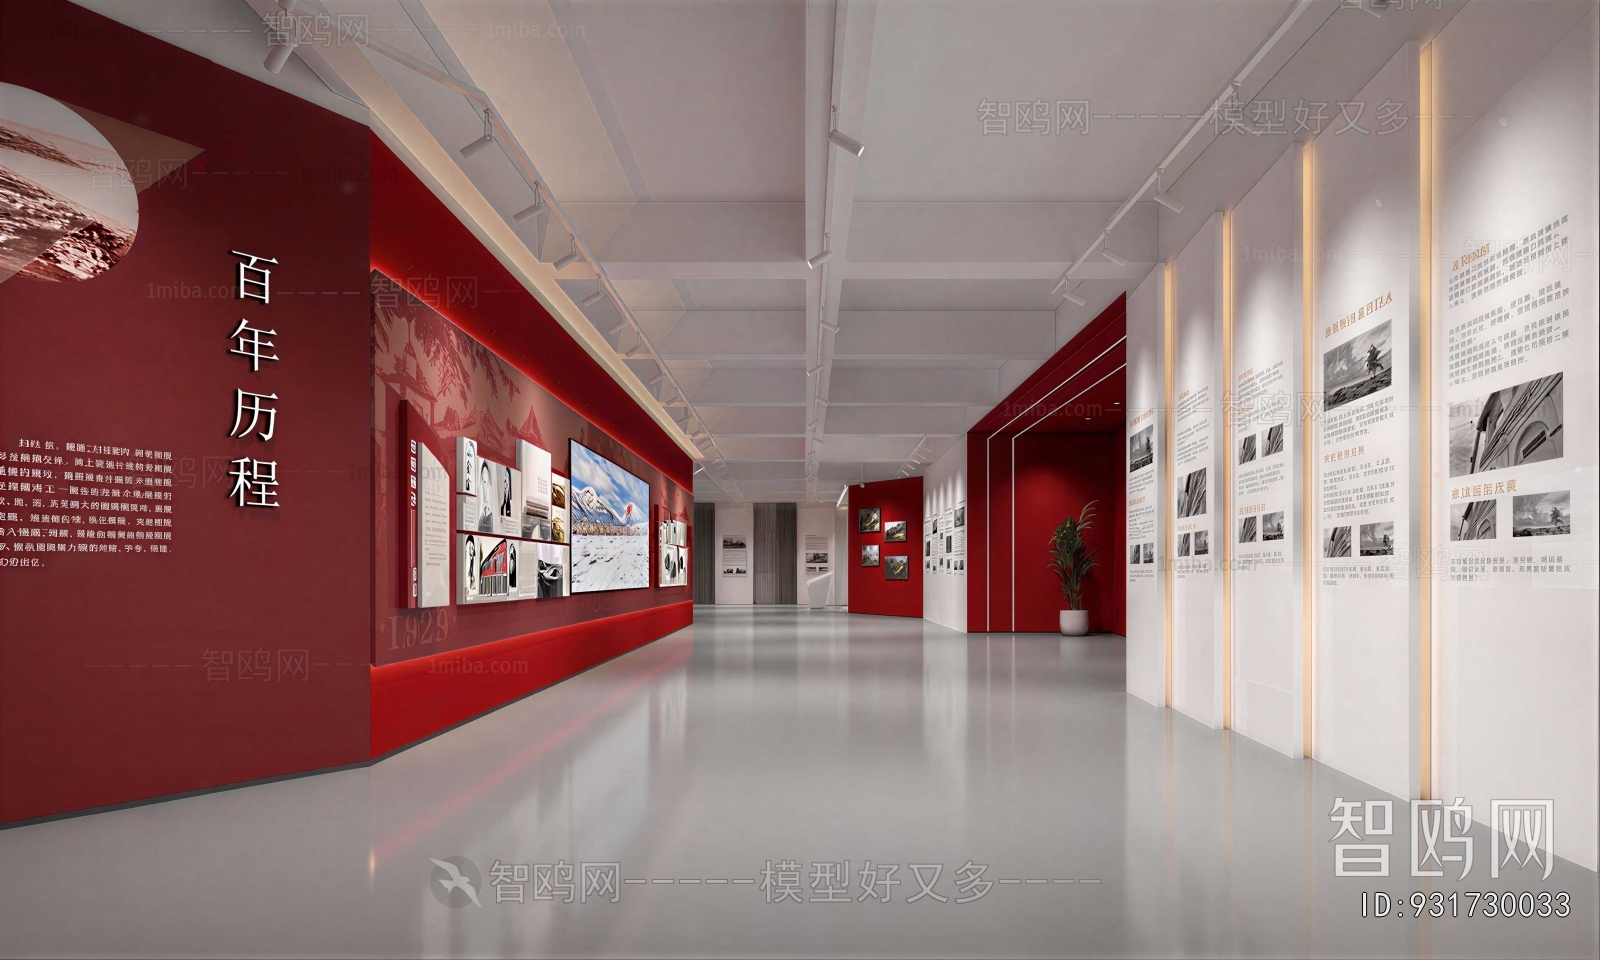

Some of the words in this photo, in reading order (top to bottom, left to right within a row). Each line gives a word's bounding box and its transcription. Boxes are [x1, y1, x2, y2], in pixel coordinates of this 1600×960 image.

[229, 250, 280, 507] 百年历程
[388, 609, 449, 650] 1929
